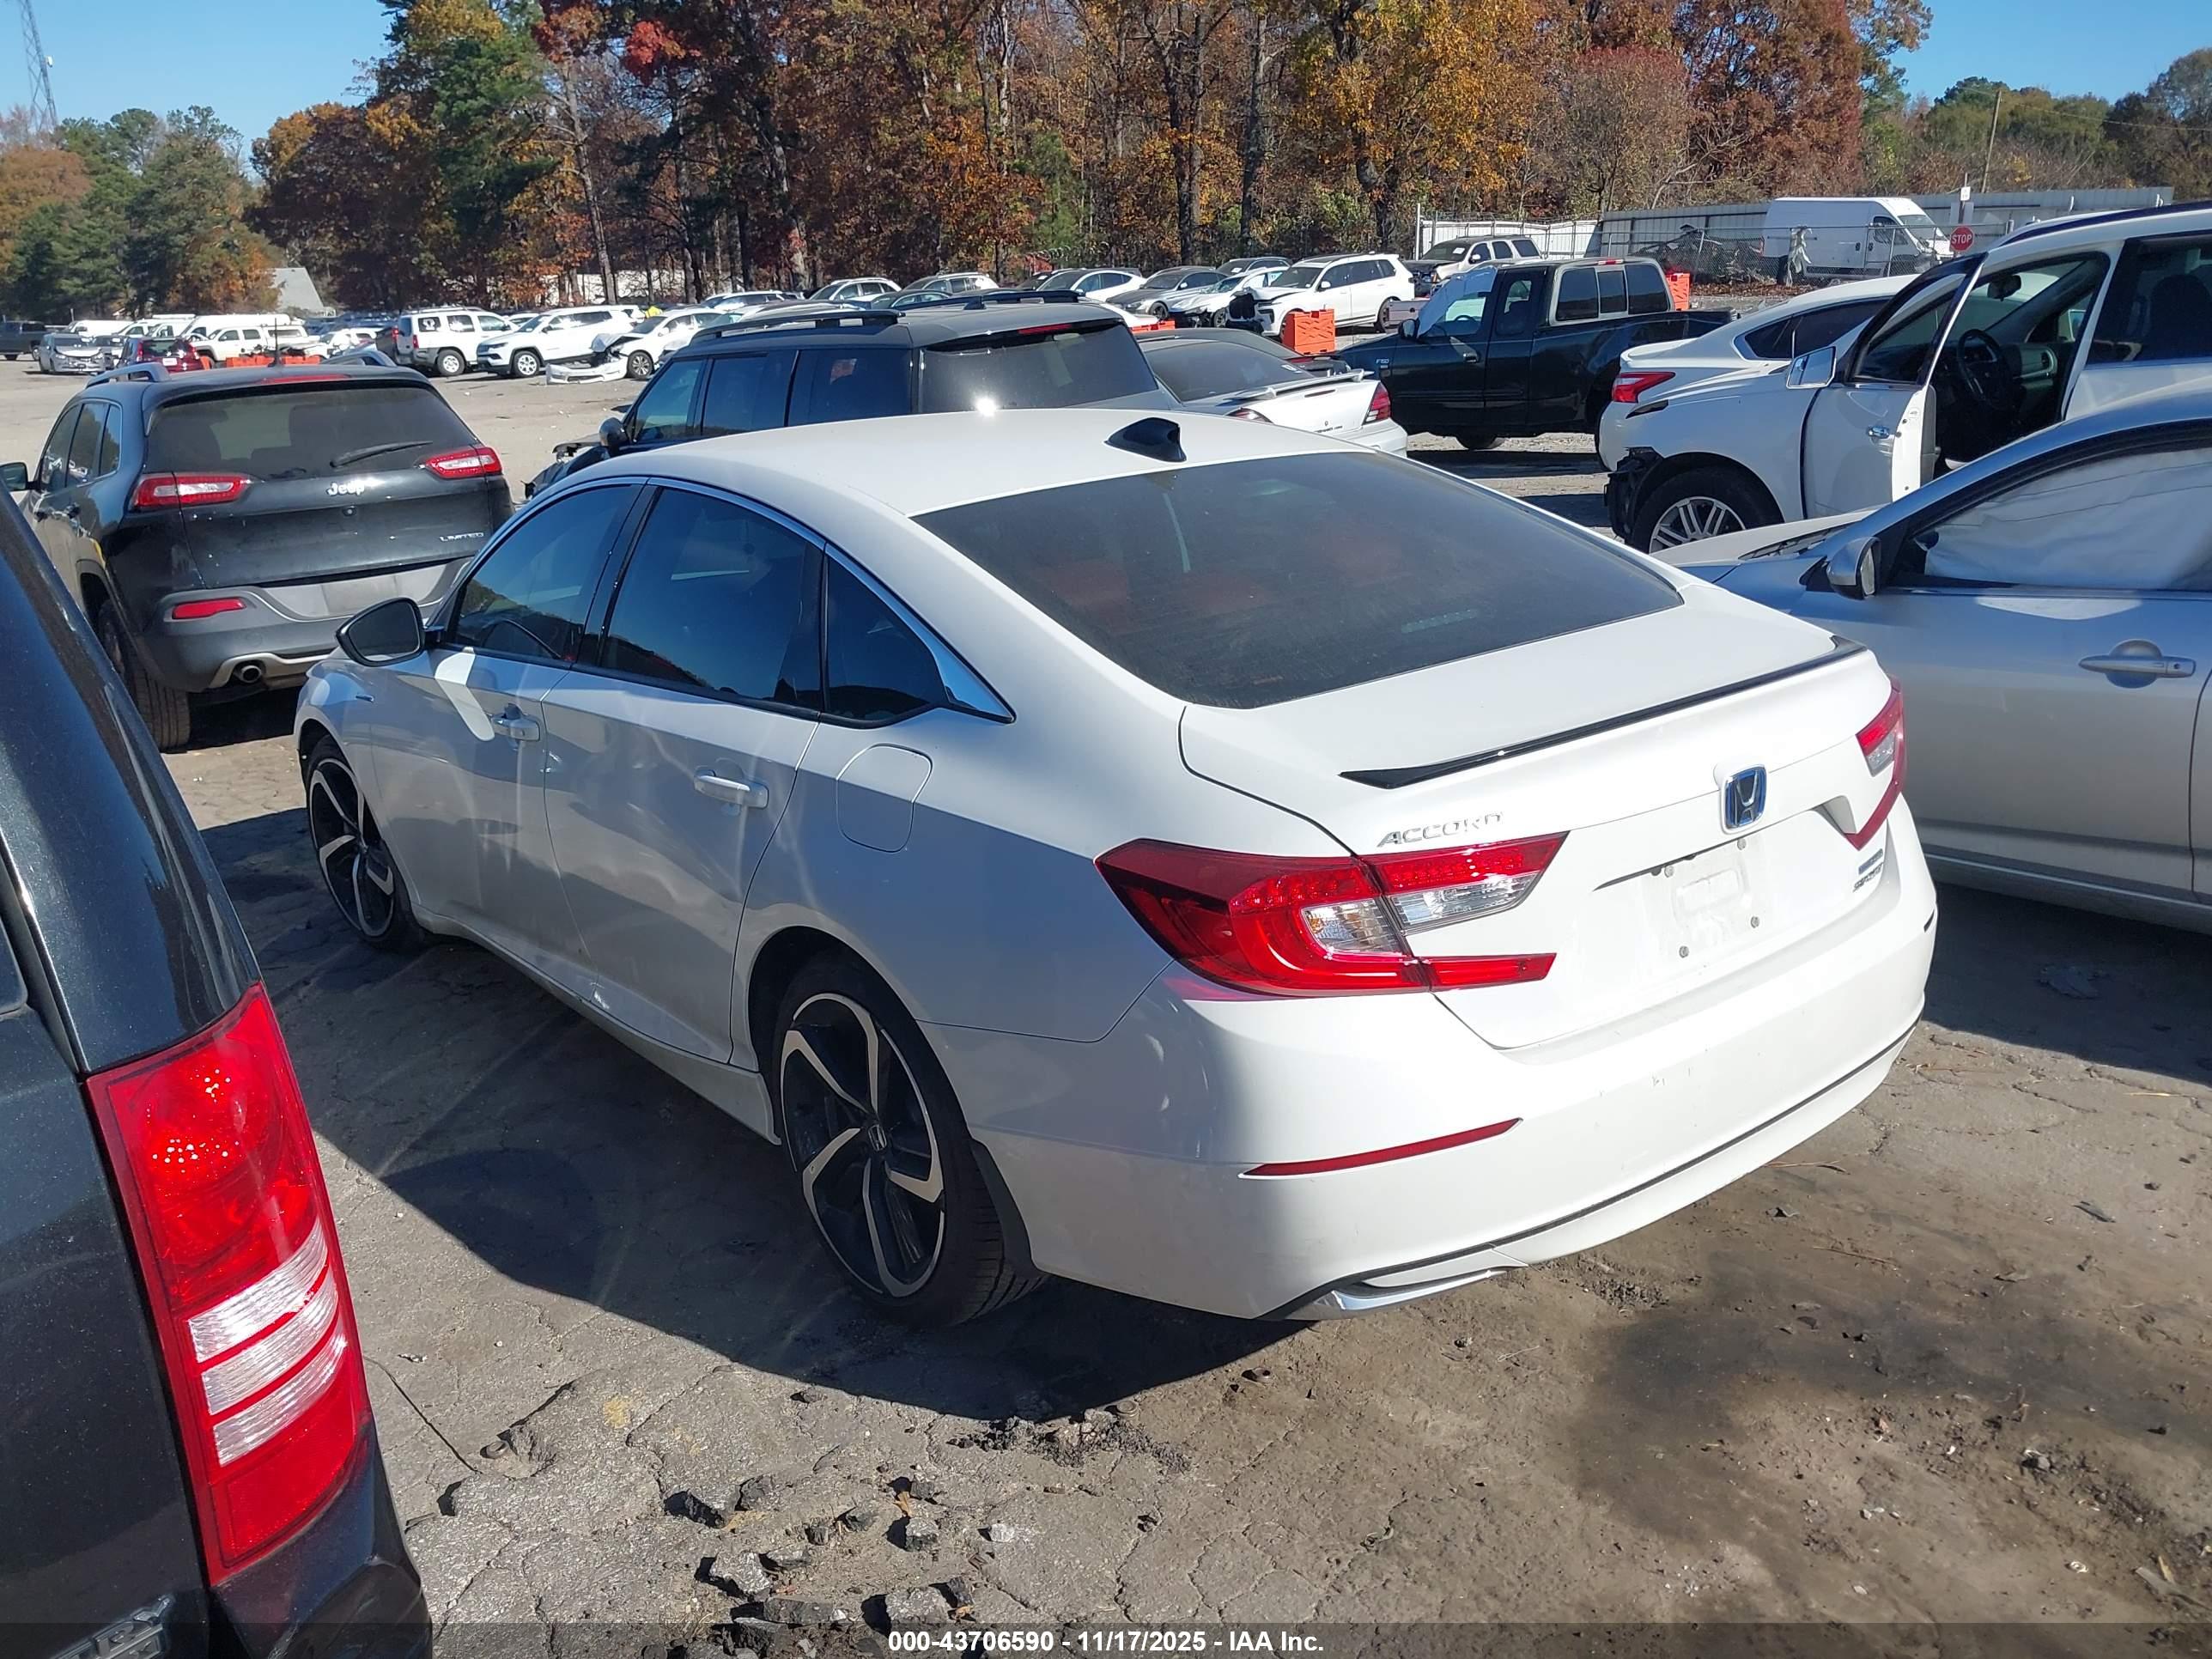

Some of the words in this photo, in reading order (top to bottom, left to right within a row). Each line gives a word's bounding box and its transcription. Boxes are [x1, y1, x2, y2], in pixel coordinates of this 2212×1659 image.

[1952, 234, 1972, 244] STOP
[326, 481, 365, 496] Jeep
[439, 532, 484, 542] LIMITED
[1376, 812, 1502, 848] ACCORD
